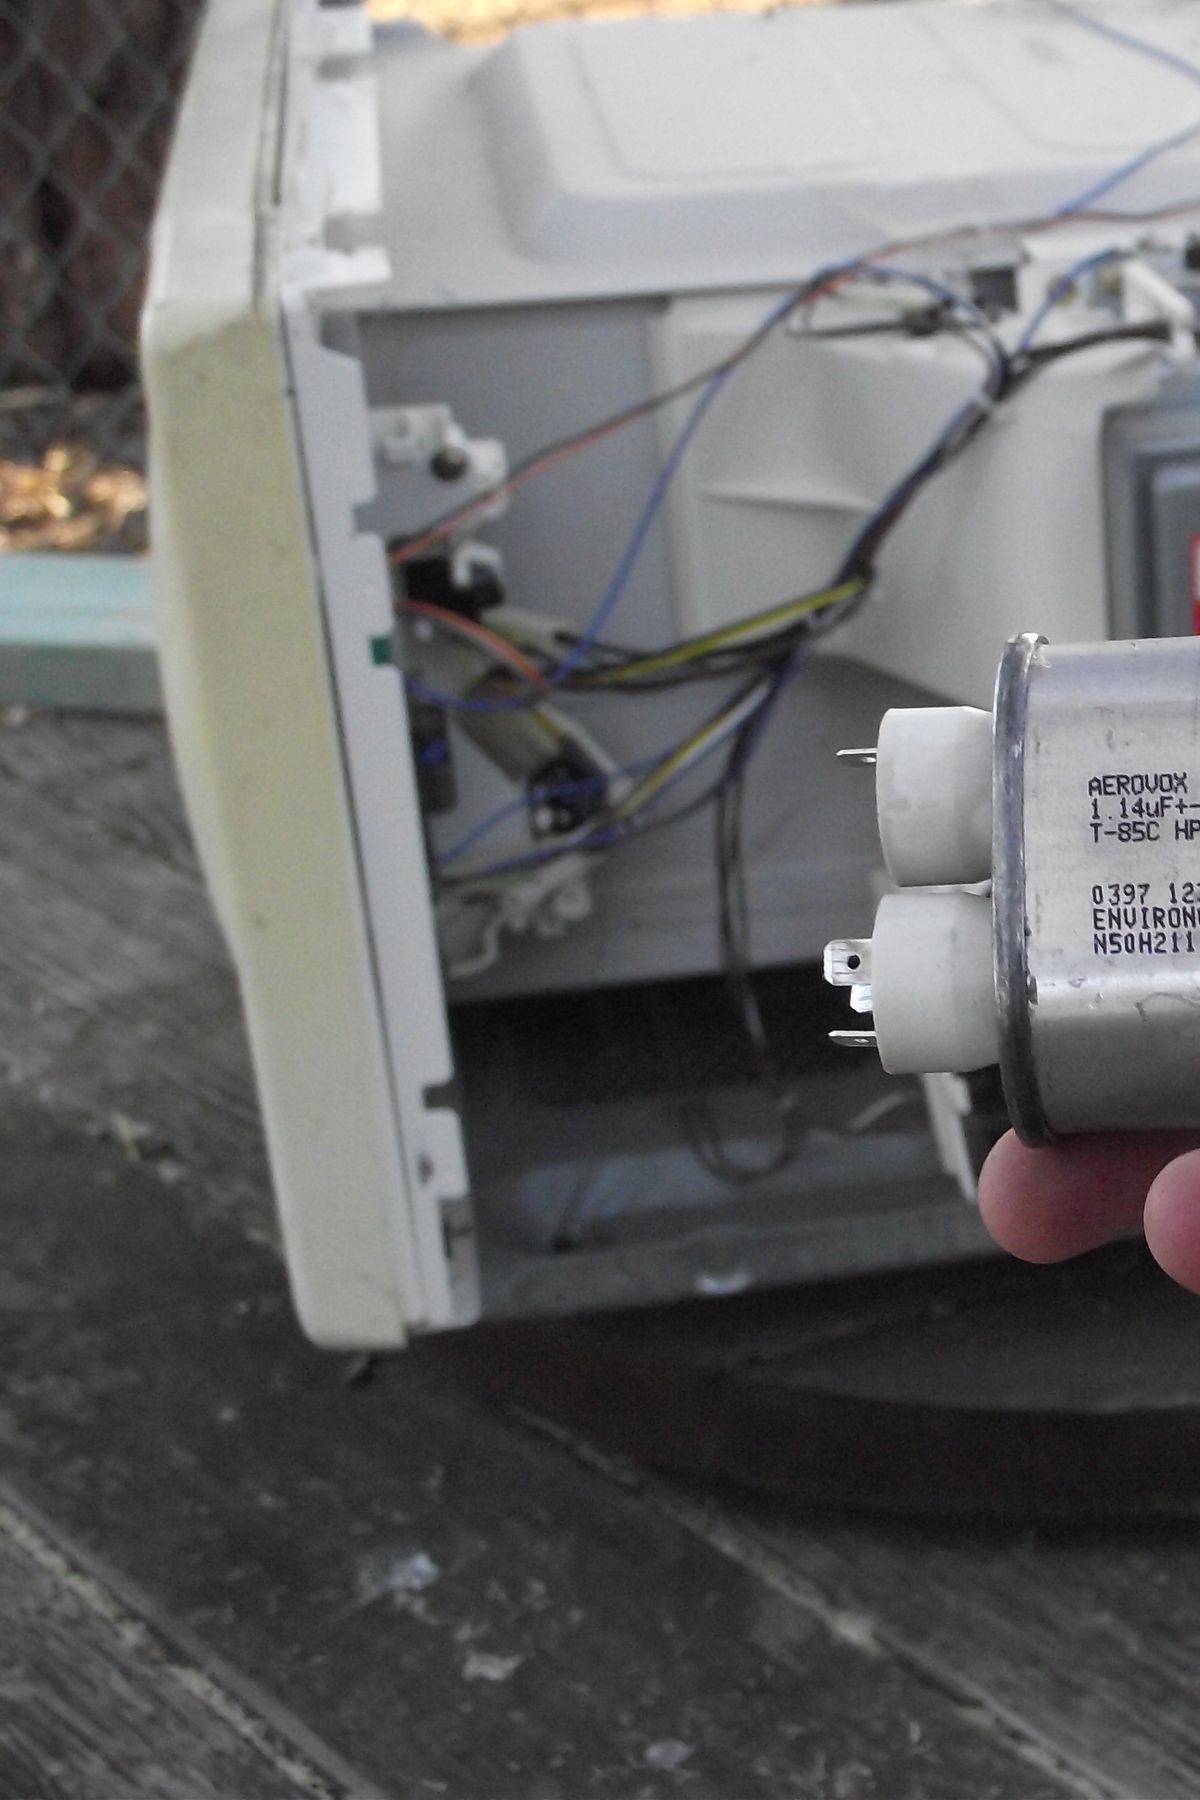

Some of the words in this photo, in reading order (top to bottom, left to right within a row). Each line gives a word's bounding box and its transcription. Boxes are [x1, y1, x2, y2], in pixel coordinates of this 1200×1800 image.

[1088, 773, 1188, 796] AEROVOX
[1090, 820, 1160, 842] T-85C
[1092, 884, 1150, 905] 0397
